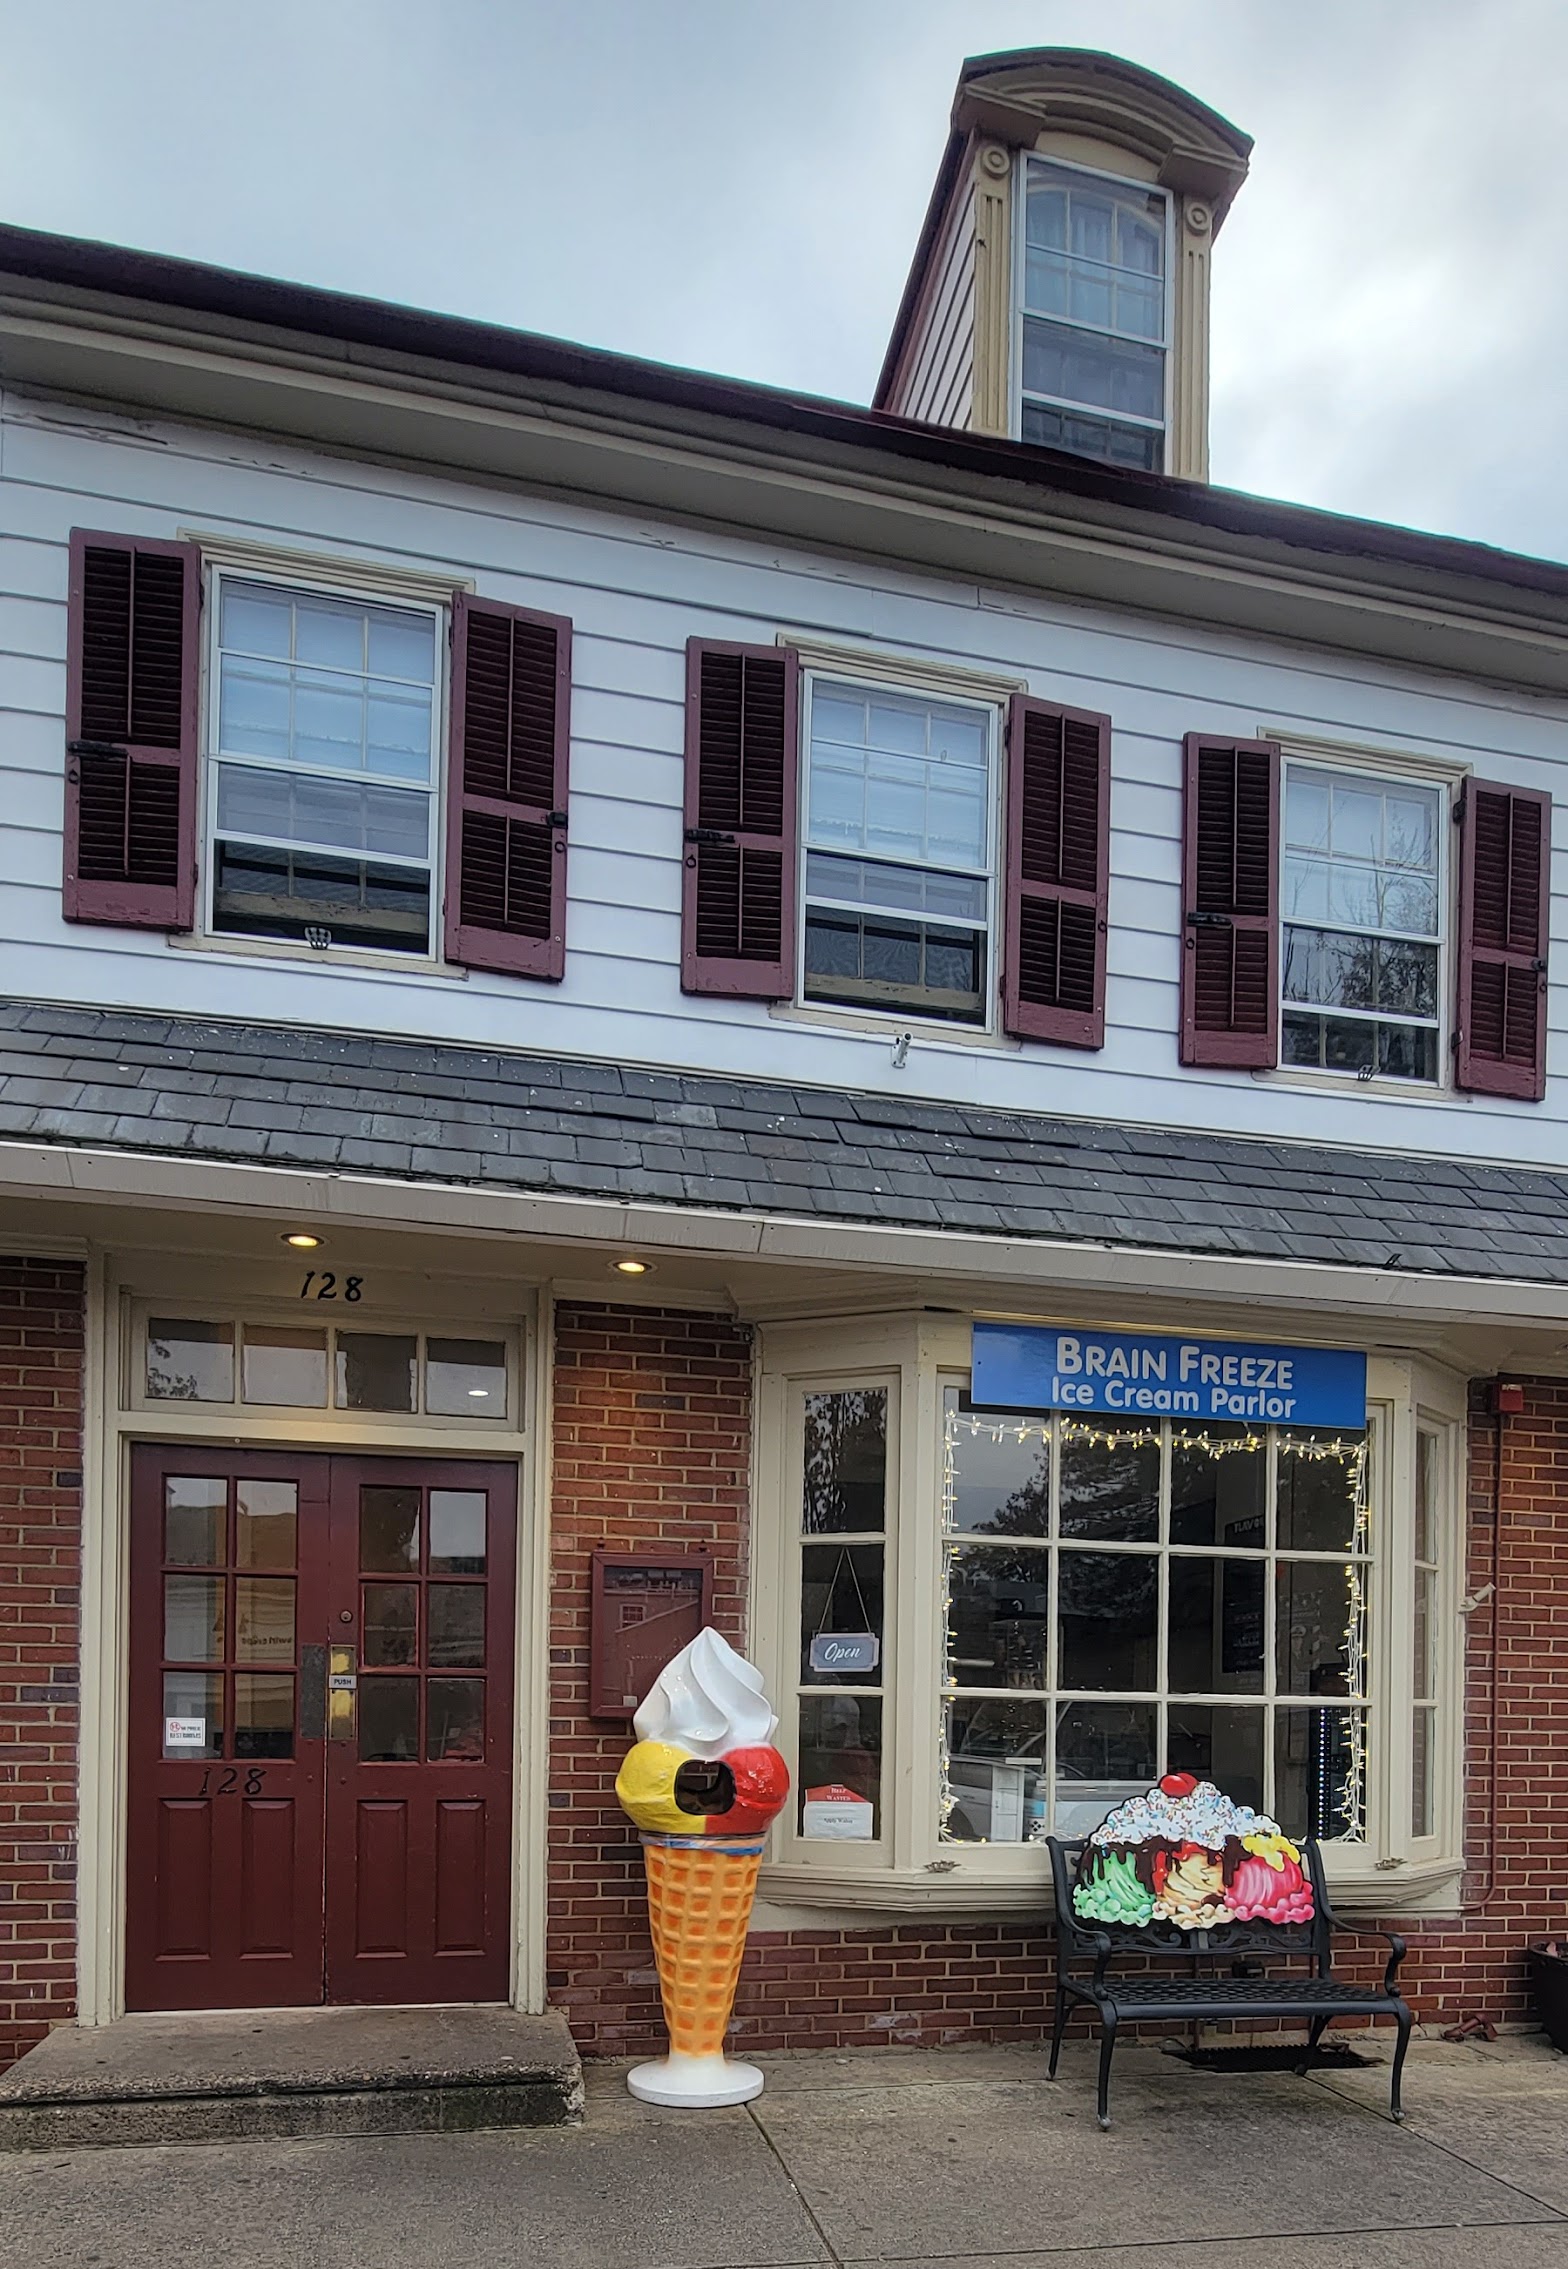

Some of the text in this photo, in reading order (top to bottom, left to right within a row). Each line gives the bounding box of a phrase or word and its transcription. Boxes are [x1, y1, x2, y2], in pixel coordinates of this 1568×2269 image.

[300, 1270, 364, 1302] 128
[1056, 1336, 1294, 1390] BRAIN FREEZE
[1052, 1375, 1297, 1419] Ice Cream Parlor
[824, 1642, 861, 1663] Open
[198, 1767, 268, 1796] 128
